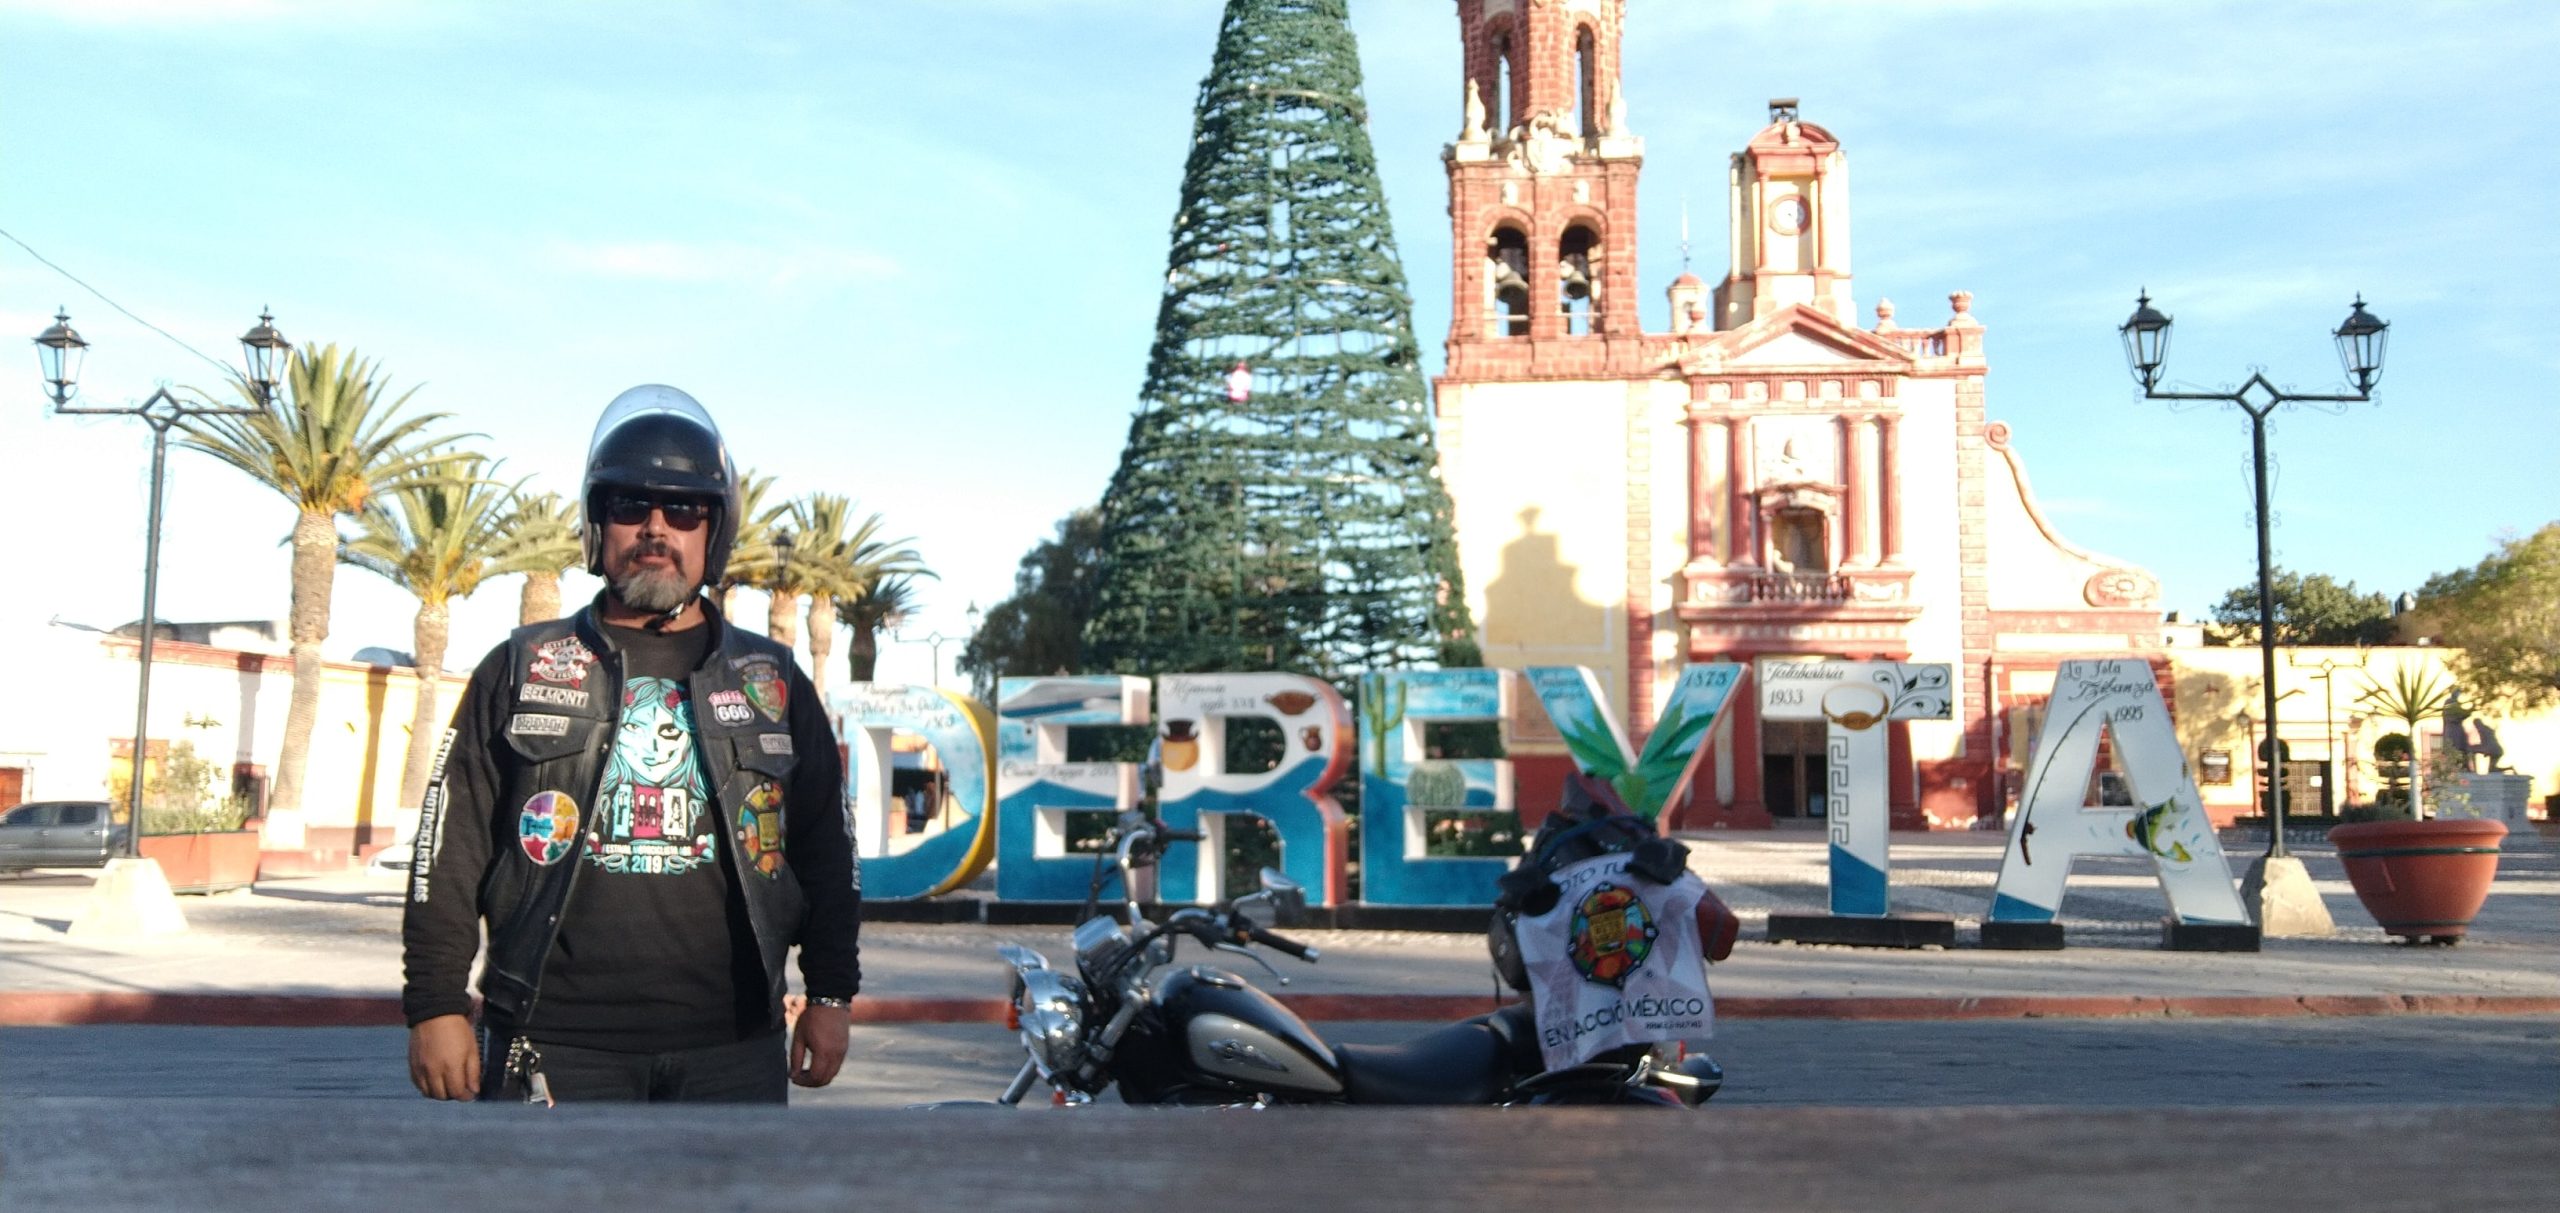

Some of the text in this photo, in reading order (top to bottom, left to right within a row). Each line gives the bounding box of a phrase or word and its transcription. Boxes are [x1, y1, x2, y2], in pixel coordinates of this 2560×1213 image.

[523, 685, 586, 705] BELMONT
[1770, 690, 1803, 705] 1933
[717, 705, 750, 722] 666
[432, 728, 458, 782] FESTIVAL
[415, 786, 439, 875] MOTOCICLISTA
[631, 855, 663, 874] 2019
[1560, 867, 1596, 894] OTO
[1544, 1025, 1570, 1048] EN
[1626, 994, 1704, 1018] MÉXICO
